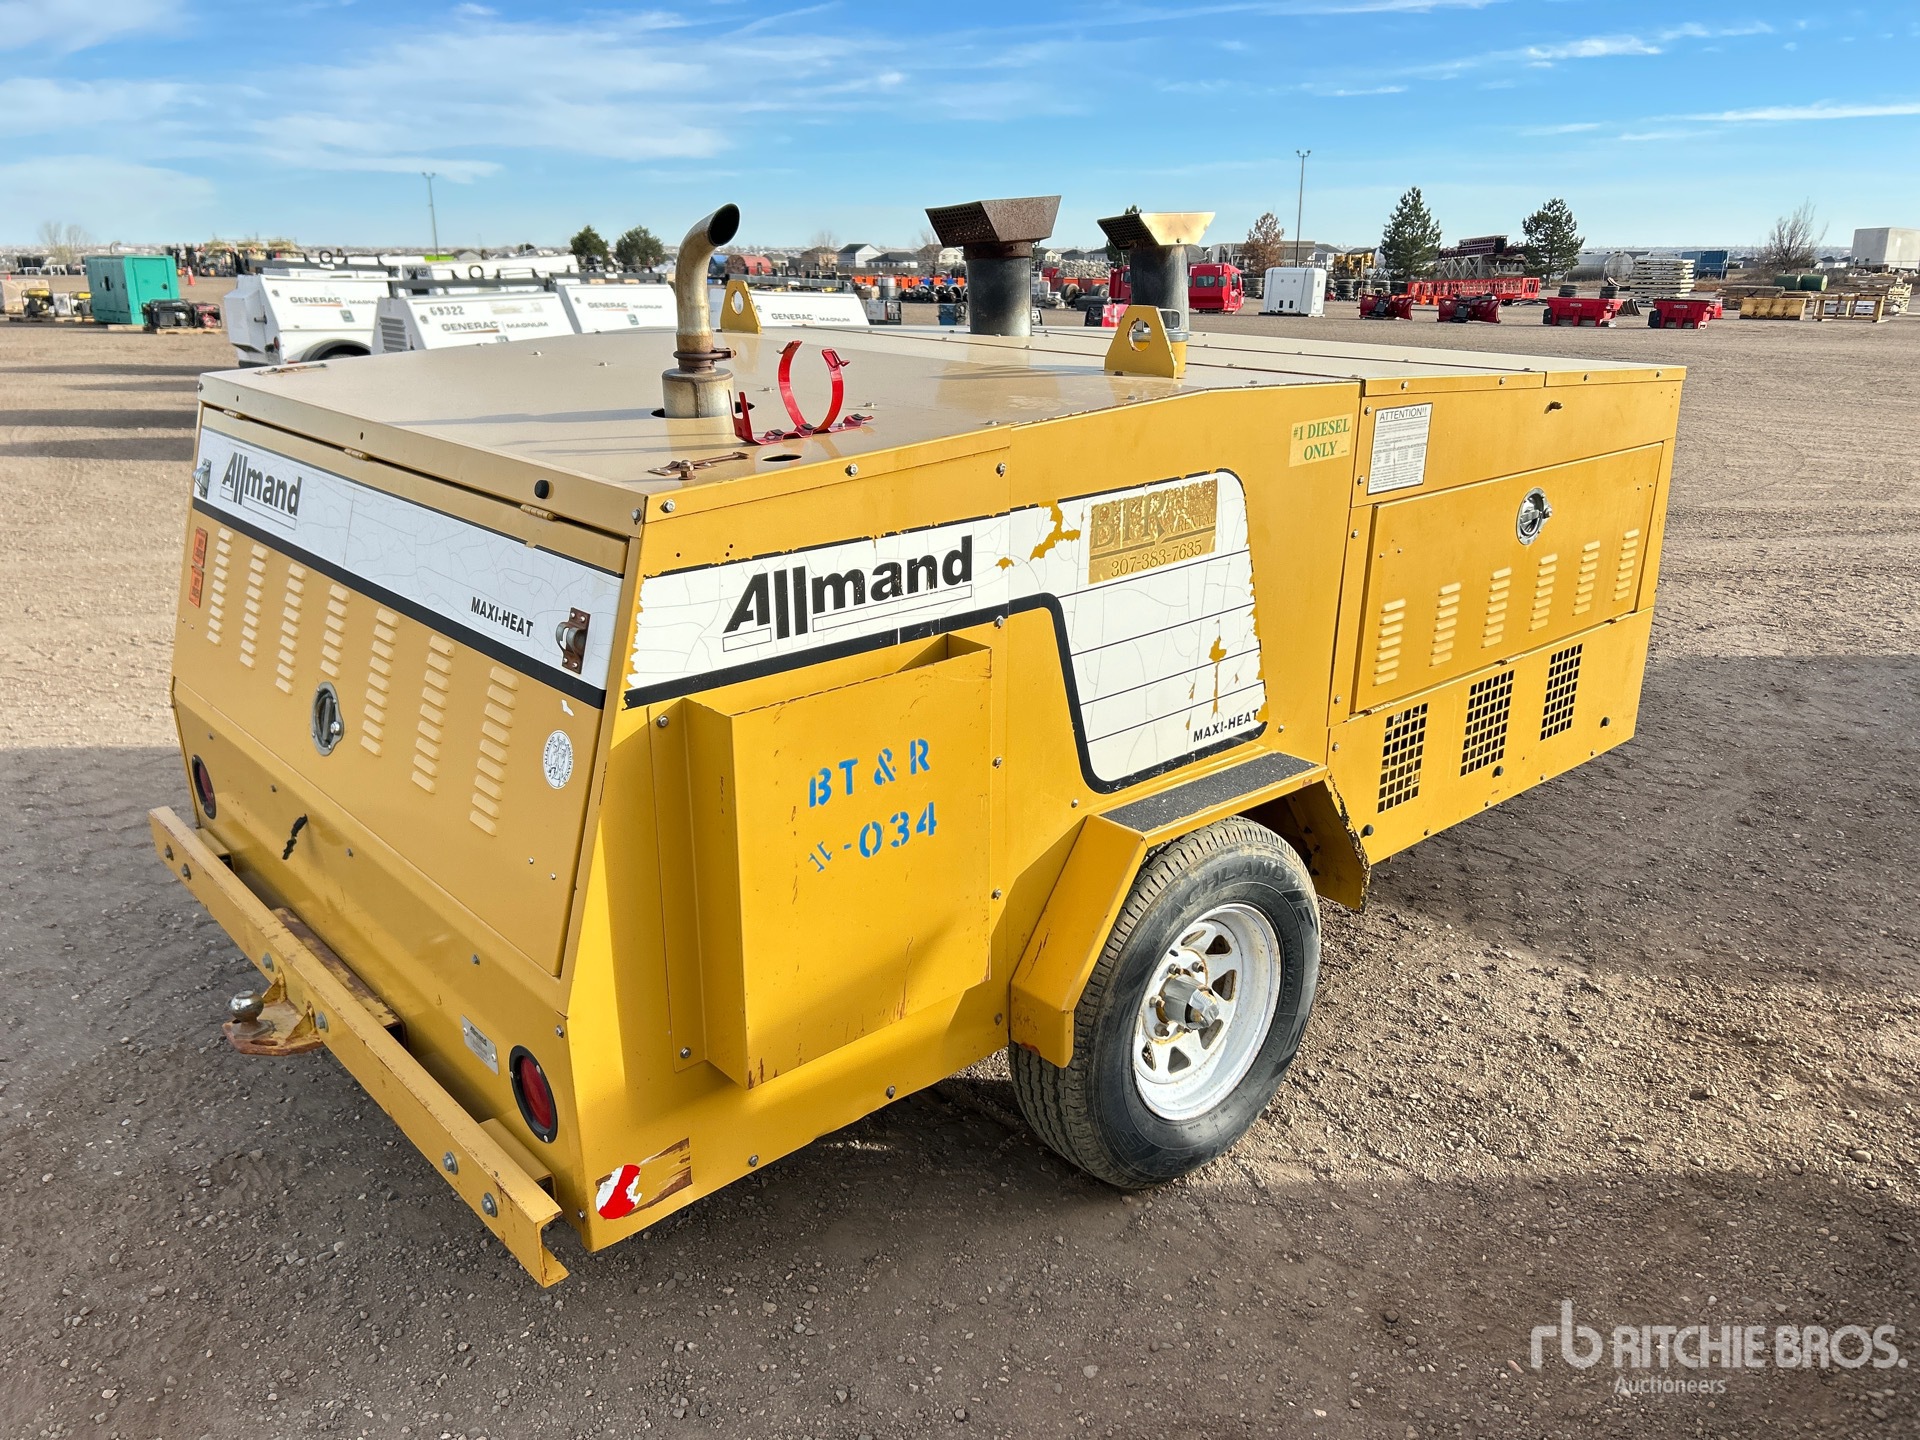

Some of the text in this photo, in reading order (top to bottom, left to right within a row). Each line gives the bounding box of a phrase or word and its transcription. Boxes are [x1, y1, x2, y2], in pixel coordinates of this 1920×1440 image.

[289, 296, 341, 304] GENERAC
[771, 312, 814, 321] GENERAC
[441, 321, 498, 331] GENERAC
[1307, 418, 1351, 439] DIESEL
[1303, 440, 1338, 461] ONLY
[221, 451, 303, 517] Allmand
[1111, 540, 1202, 577] 307-383-7635
[722, 534, 973, 641] Allmand
[470, 596, 534, 638] MAXI-HEAT
[1193, 708, 1259, 742] MAXI-HEAT
[873, 747, 897, 786] &
[909, 738, 931, 775] R
